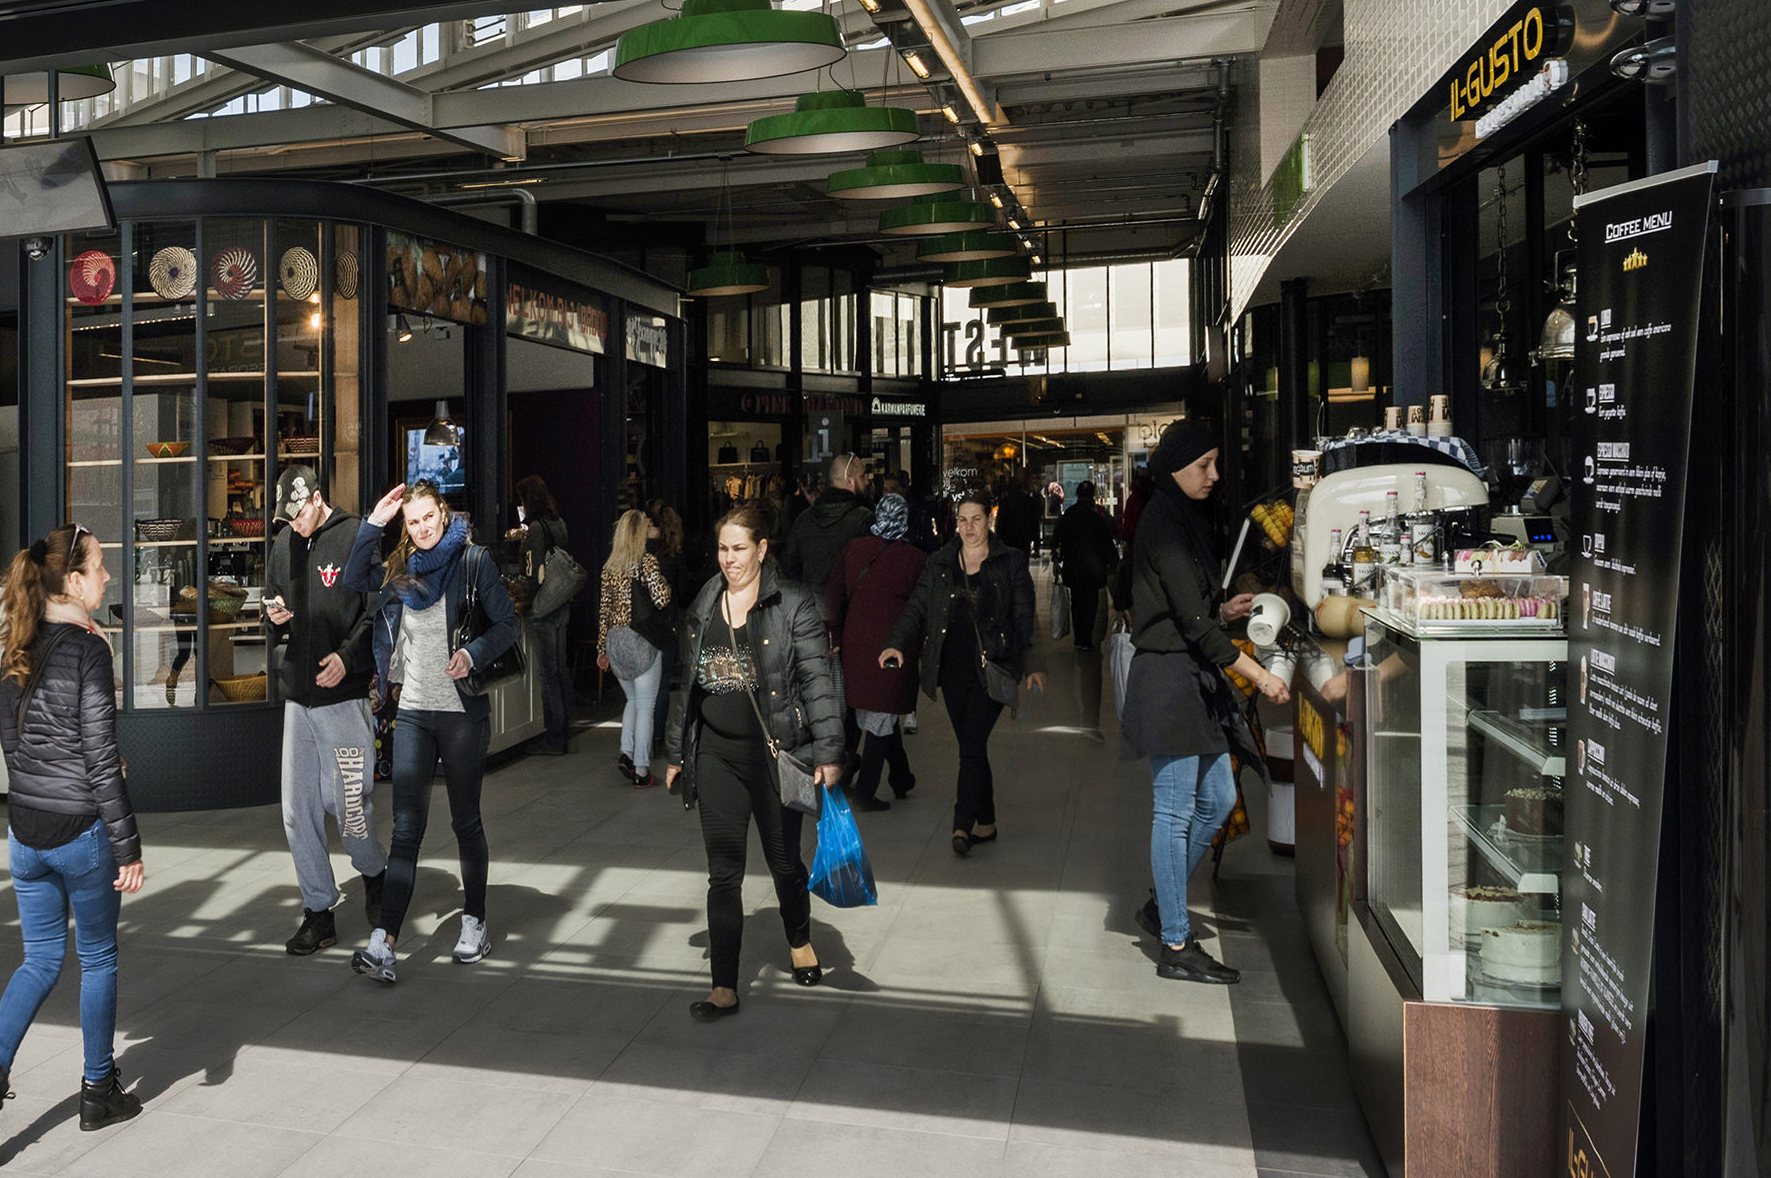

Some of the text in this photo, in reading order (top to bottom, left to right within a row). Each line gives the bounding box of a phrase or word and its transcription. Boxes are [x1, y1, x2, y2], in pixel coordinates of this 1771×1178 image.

[1606, 211, 1673, 240] COFFEE MENU
[336, 756, 369, 840] HARDCORE
